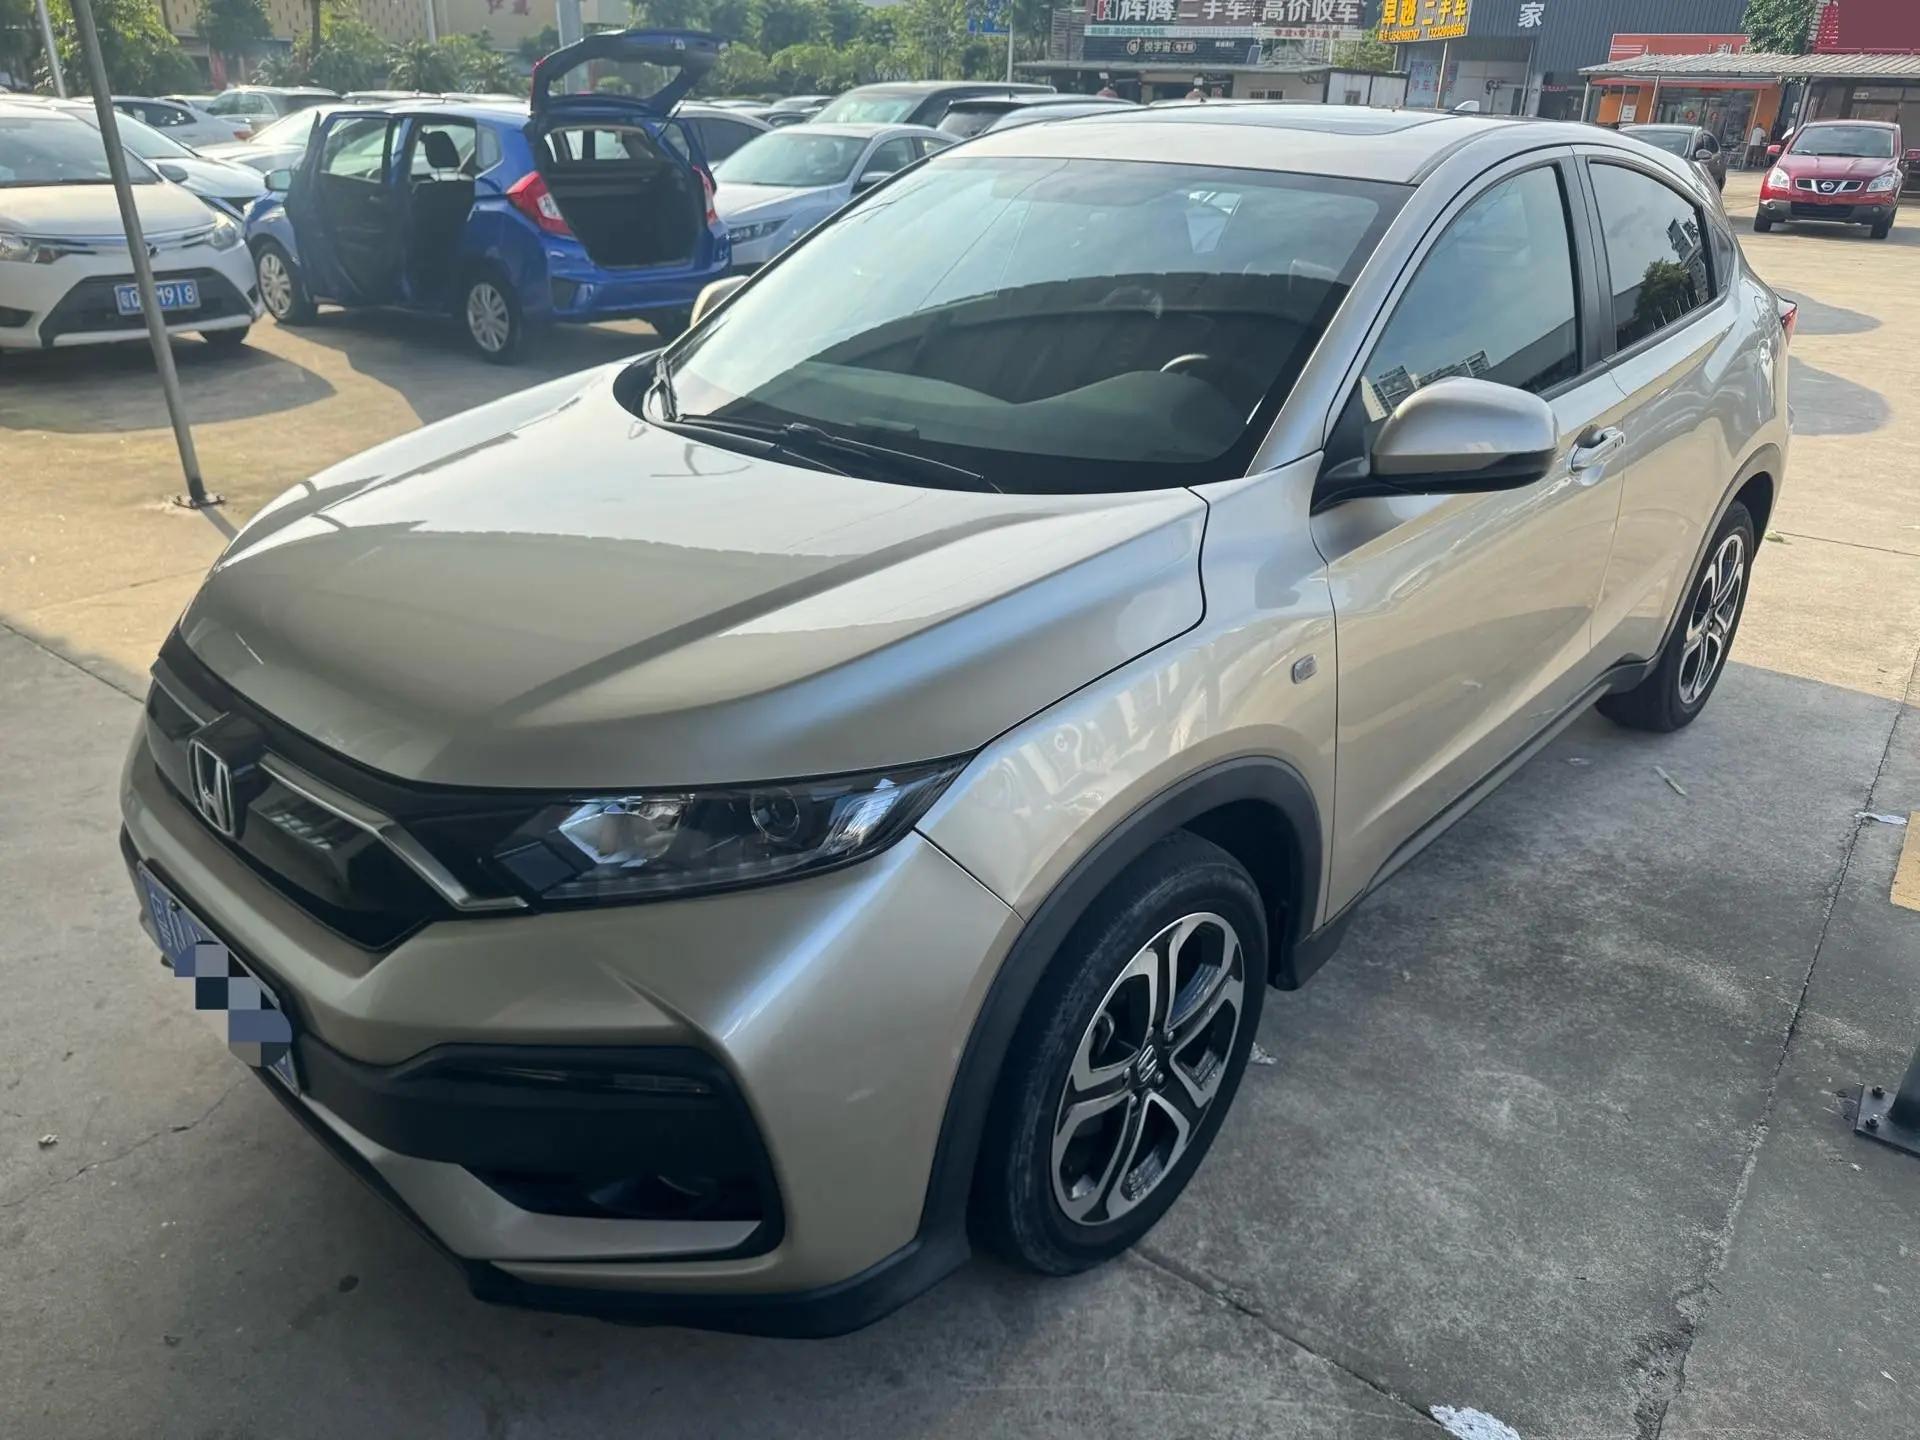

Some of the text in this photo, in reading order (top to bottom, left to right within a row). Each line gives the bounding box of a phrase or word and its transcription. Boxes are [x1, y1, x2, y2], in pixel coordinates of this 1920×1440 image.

[1262, 0, 1359, 23] 高价收车
[1517, 1, 1545, 28] 家
